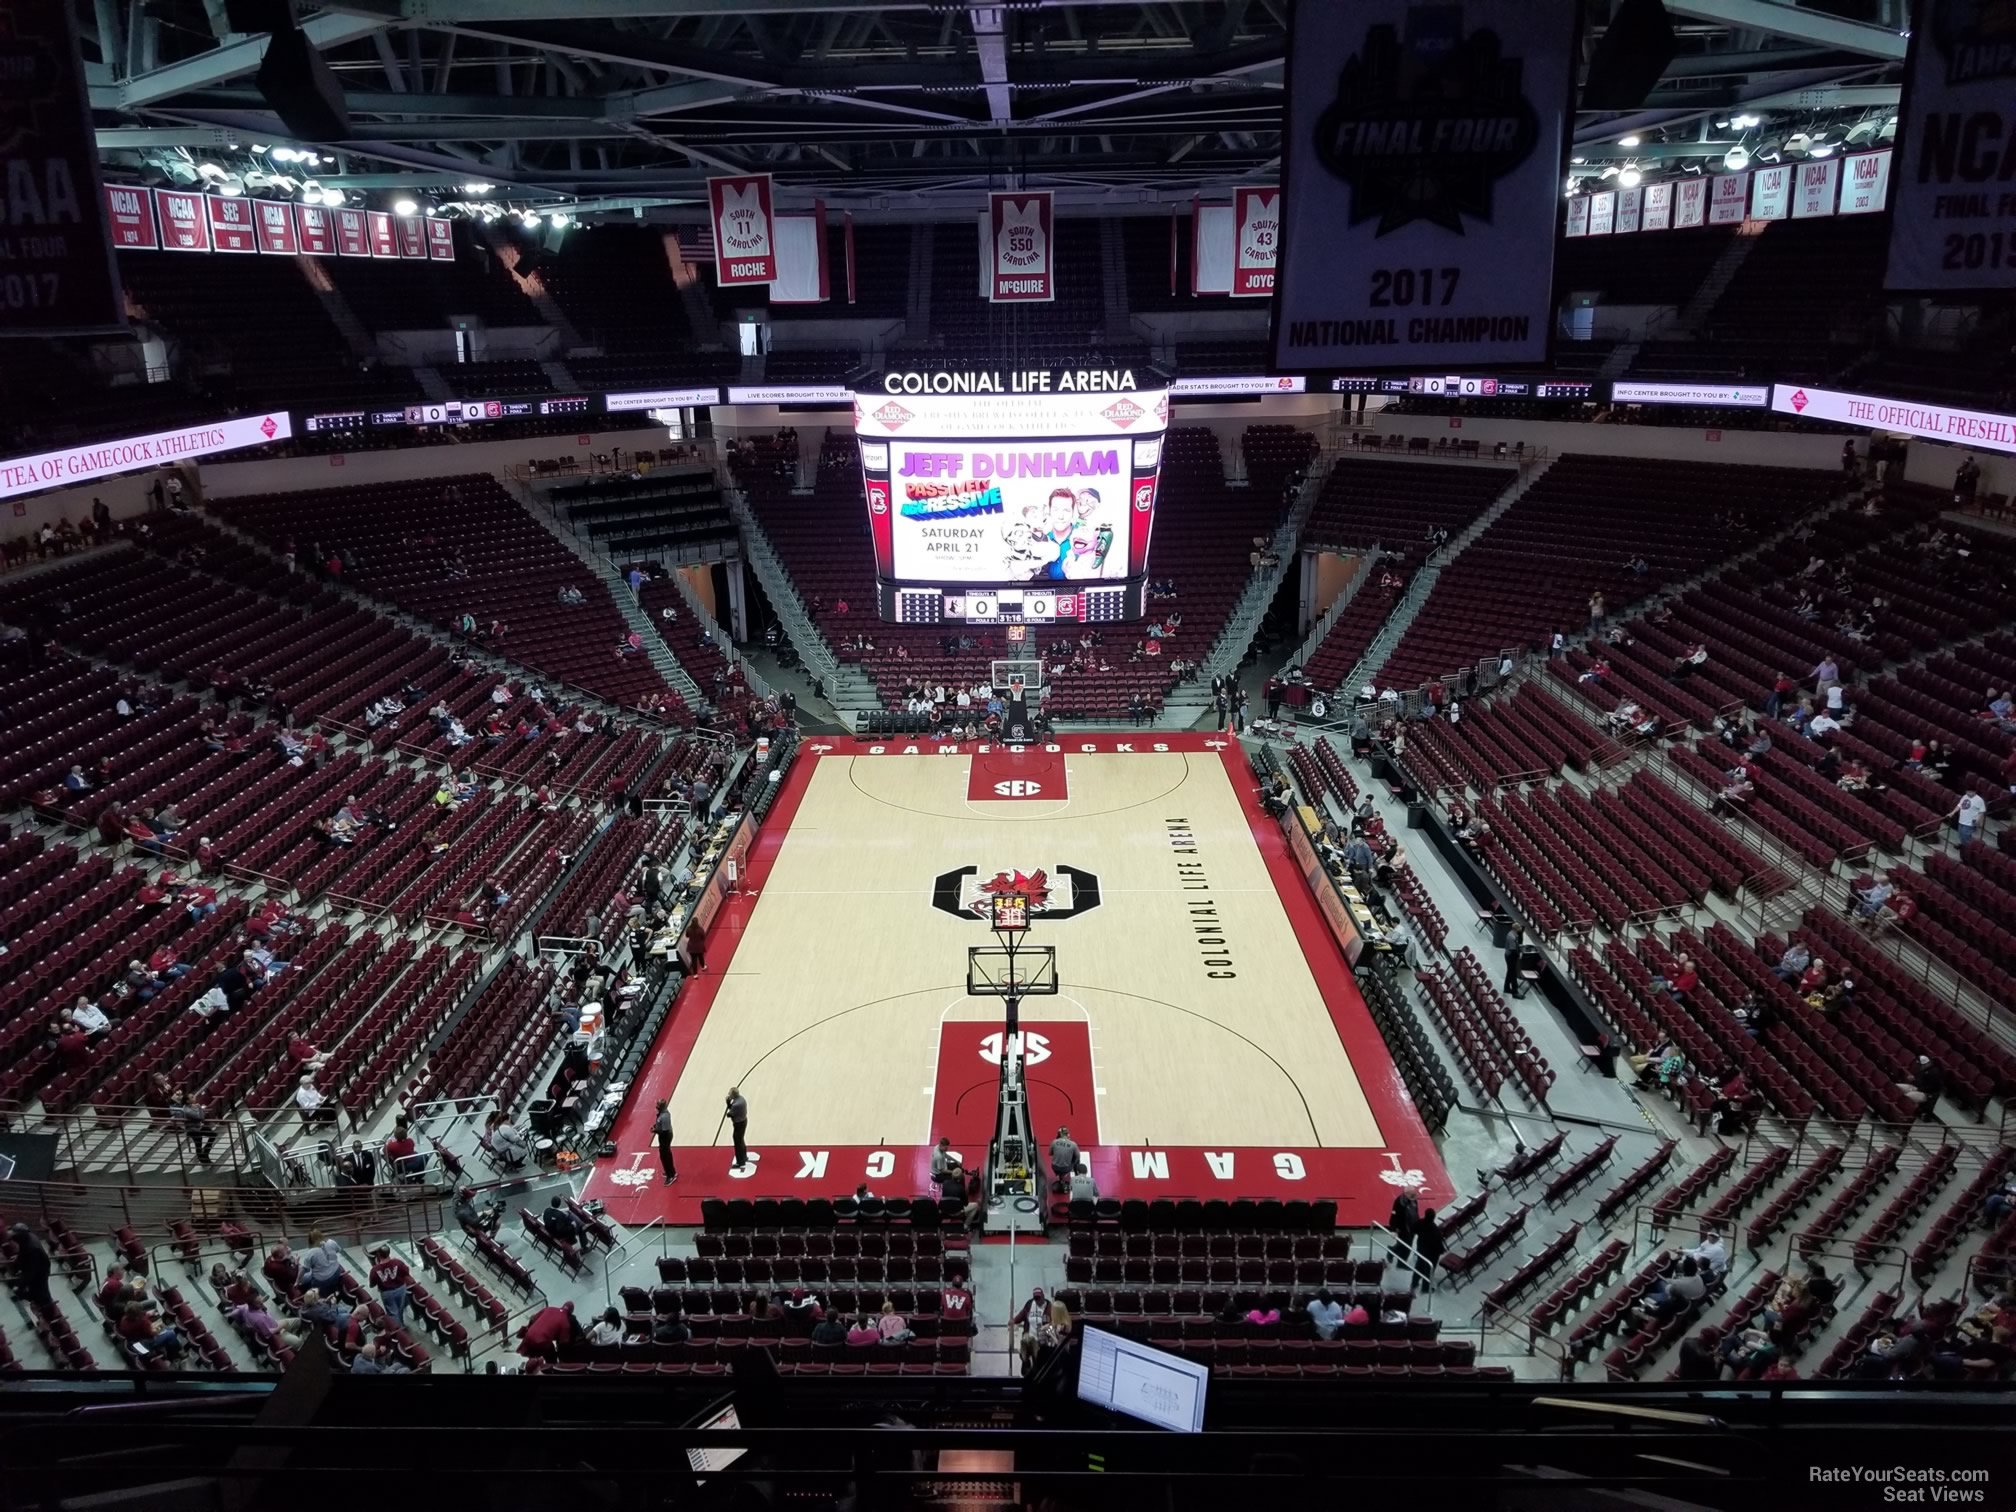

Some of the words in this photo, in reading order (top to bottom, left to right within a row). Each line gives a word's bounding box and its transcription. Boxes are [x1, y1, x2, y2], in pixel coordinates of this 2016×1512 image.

[1952, 44, 2016, 81] TAMP
[1334, 120, 1424, 156] FINAL
[1431, 117, 1521, 154] FOUR
[1804, 165, 1827, 186] NCAA
[1853, 158, 1879, 180] NCAA
[1723, 178, 1736, 196] SEC
[1762, 171, 1781, 191] NCAA
[0, 158, 81, 224] AA
[1652, 189, 1663, 204] SEC
[110, 191, 141, 214] NCAA
[168, 197, 195, 220] NCAA
[1856, 196, 1869, 208] 2003
[1934, 195, 1990, 218] FINAL
[222, 202, 239, 222] SEC
[263, 205, 285, 225] NCAA
[304, 208, 325, 228] NCAA
[730, 209, 756, 220] SOUTH
[341, 212, 359, 230] NCAA
[738, 221, 751, 234] 11
[1252, 220, 1278, 231] SOUTH
[123, 230, 138, 243] 1974
[1008, 226, 1035, 237] SOUTH
[1257, 232, 1272, 246] 43
[20, 235, 68, 258] FOUR
[727, 234, 763, 249] CAROLINA
[1010, 239, 1033, 251] 550
[1002, 251, 1040, 266] CAROLINA
[1245, 246, 1277, 260] CAROLIN
[731, 262, 766, 277] ROCHE
[1000, 280, 1044, 294] McGUIRE
[1246, 274, 1274, 288] JOYC
[1369, 268, 1460, 307] 2017
[1289, 319, 1399, 347] NATIONAL
[1408, 316, 1529, 344] CHAMPION
[884, 372, 1004, 394] COLONIAL
[1012, 372, 1051, 392] LIFE
[1058, 370, 1137, 391] ARENA
[1431, 380, 1439, 392] 0
[1466, 382, 1474, 392] 0
[430, 408, 439, 419] 0
[469, 405, 478, 417] 0
[1105, 410, 1143, 418] DIAMOND
[1847, 400, 1875, 420] THE
[1878, 405, 1944, 432] OFFICIAL
[1, 465, 39, 488] TEA
[41, 458, 64, 480] OF
[68, 442, 153, 475] GAMECOCK
[154, 428, 225, 457] ATHLETICS
[897, 452, 964, 478] JEFF
[972, 450, 1119, 478] DUNHAM
[905, 480, 990, 499] PASSIVELY
[900, 486, 1004, 518] AGGRESSIVE
[922, 528, 984, 538] SATURDAY
[926, 542, 960, 552] APRIL
[965, 543, 978, 552] 21
[976, 601, 987, 614] 0
[1034, 600, 1046, 614] 0
[999, 614, 1022, 622] 31:16
[870, 743, 1169, 754] GAMECOCKS
[993, 780, 1041, 796] SEC
[1165, 818, 1198, 854] ARENA
[1177, 863, 1209, 890] LIFE
[1187, 900, 1236, 979] COLONIAL
[376, 1266, 398, 1283] W
[945, 1294, 966, 1310] W
